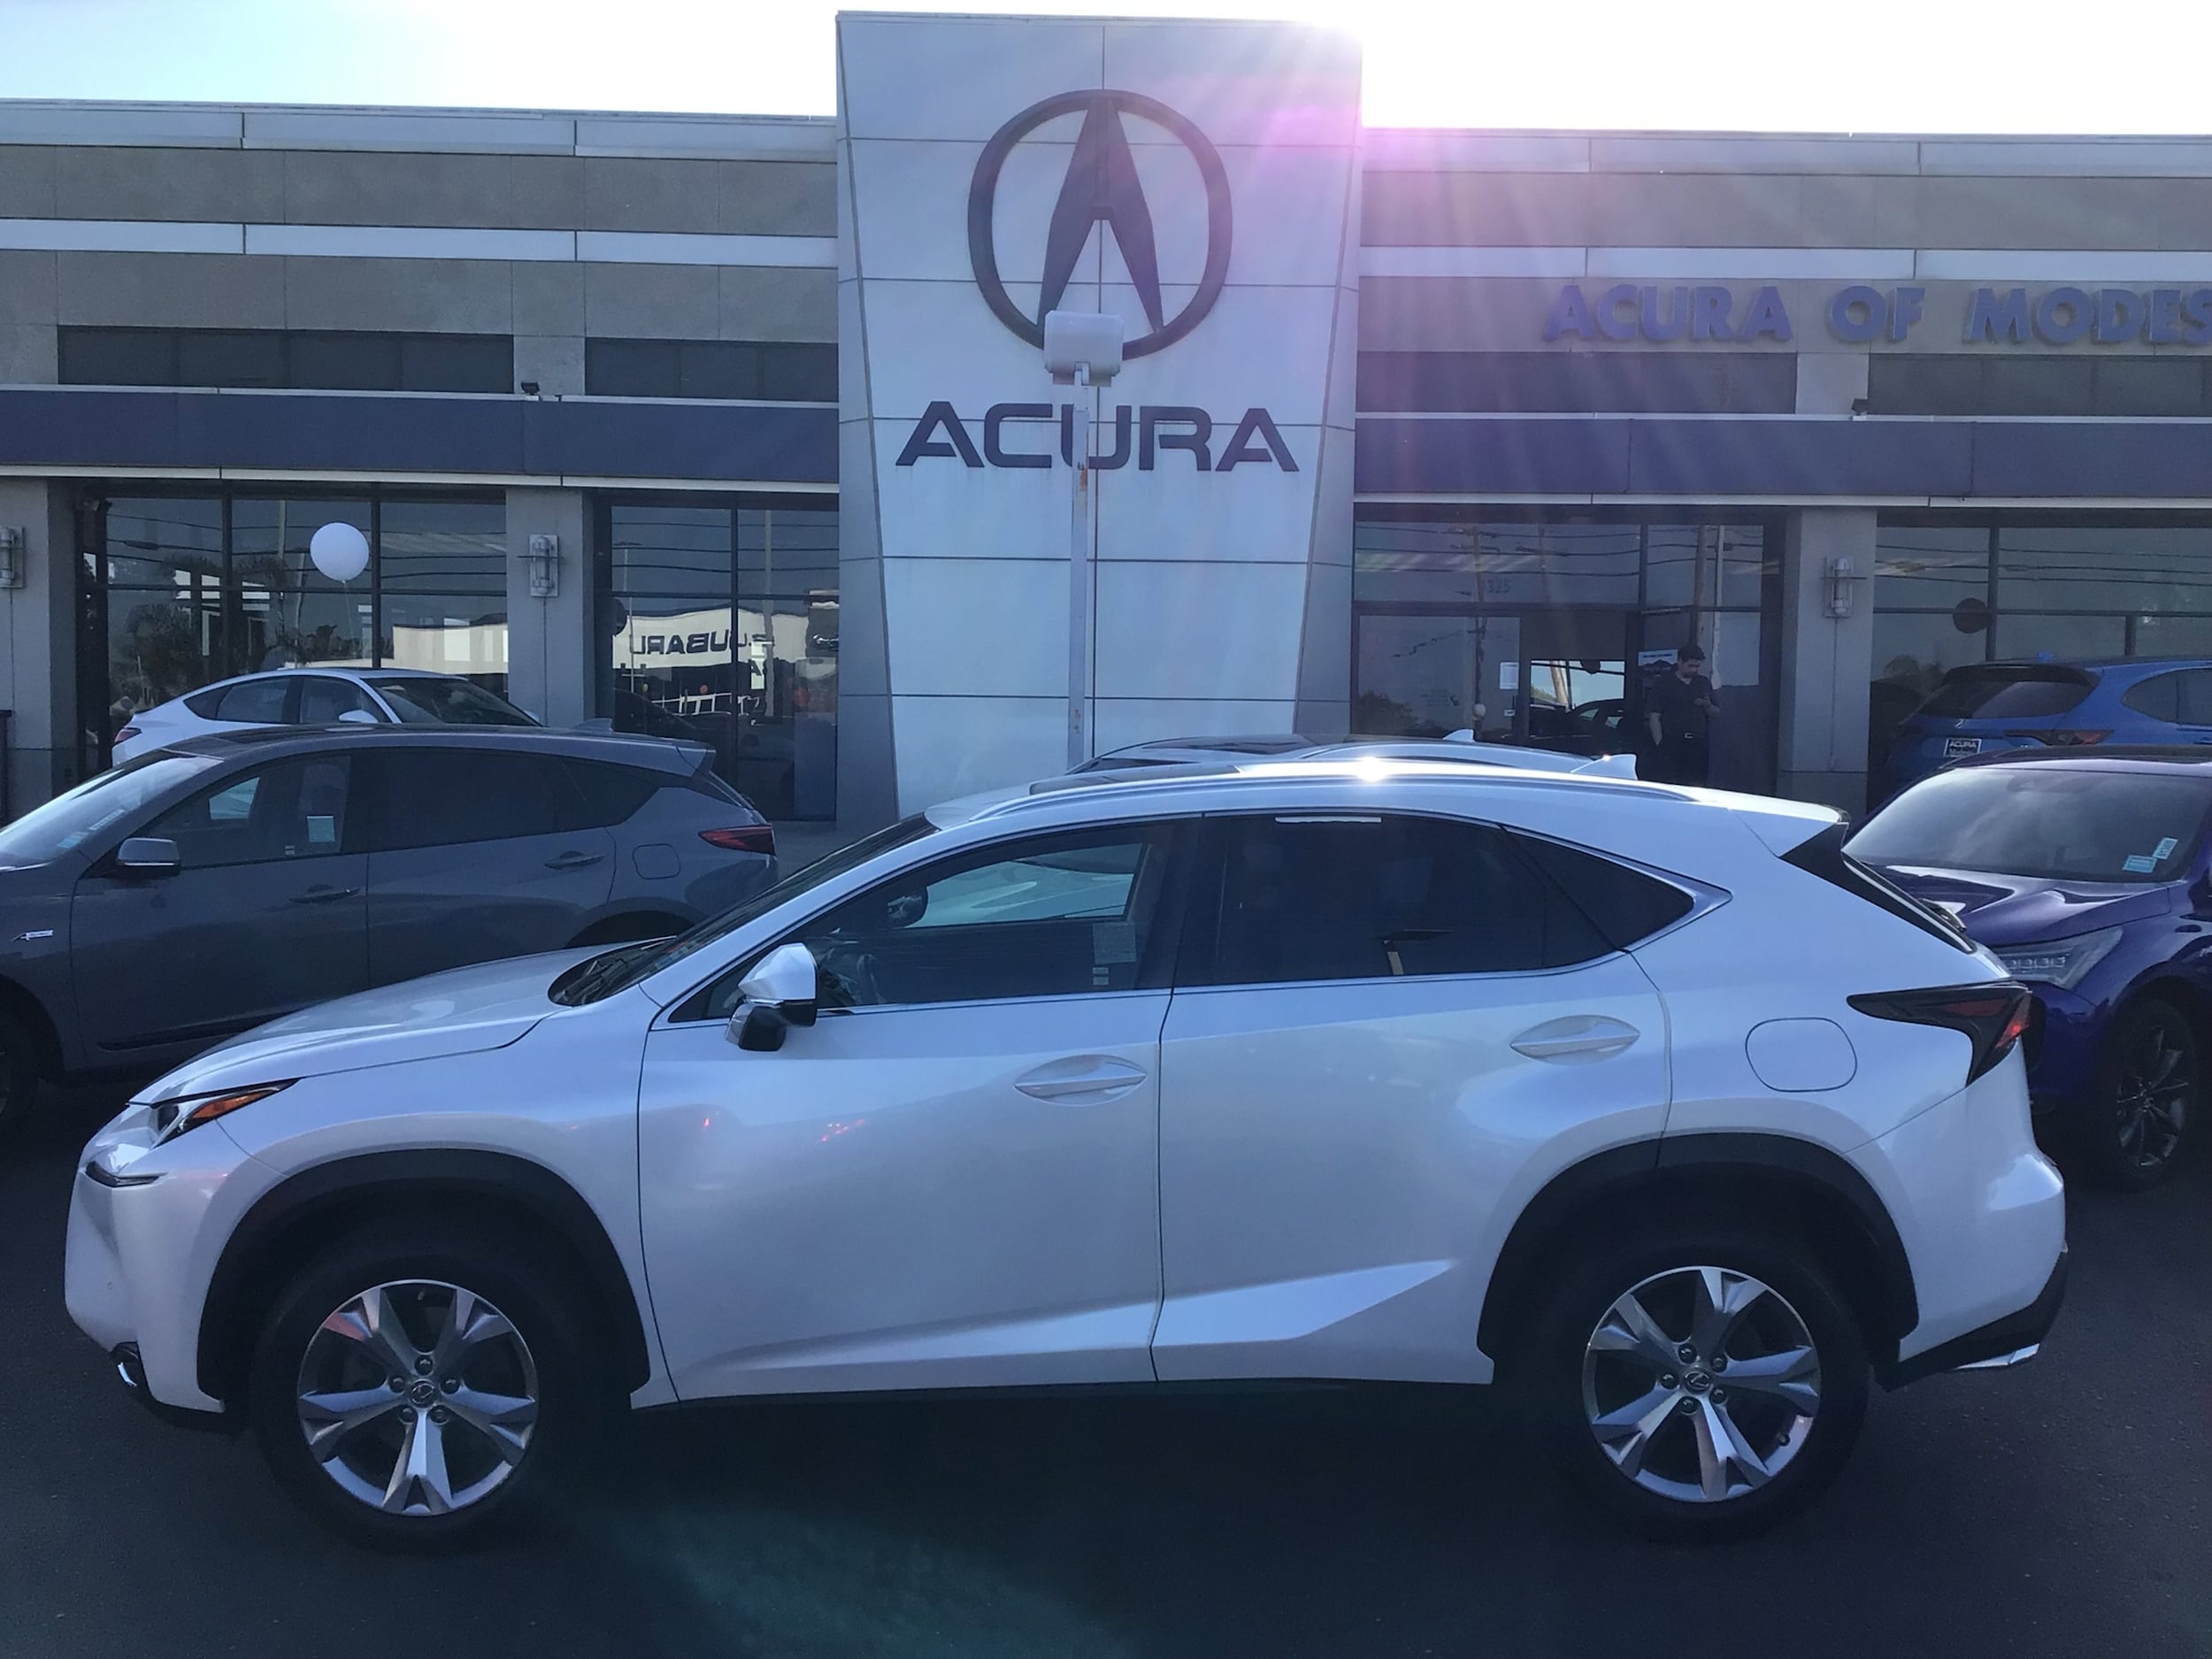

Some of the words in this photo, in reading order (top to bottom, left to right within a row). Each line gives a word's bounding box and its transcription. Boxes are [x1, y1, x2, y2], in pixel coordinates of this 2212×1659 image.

[1542, 284, 1793, 342] ACURA
[1828, 286, 1925, 342] OF
[1964, 288, 2212, 343] MODES
[895, 401, 1299, 472] ACURA
